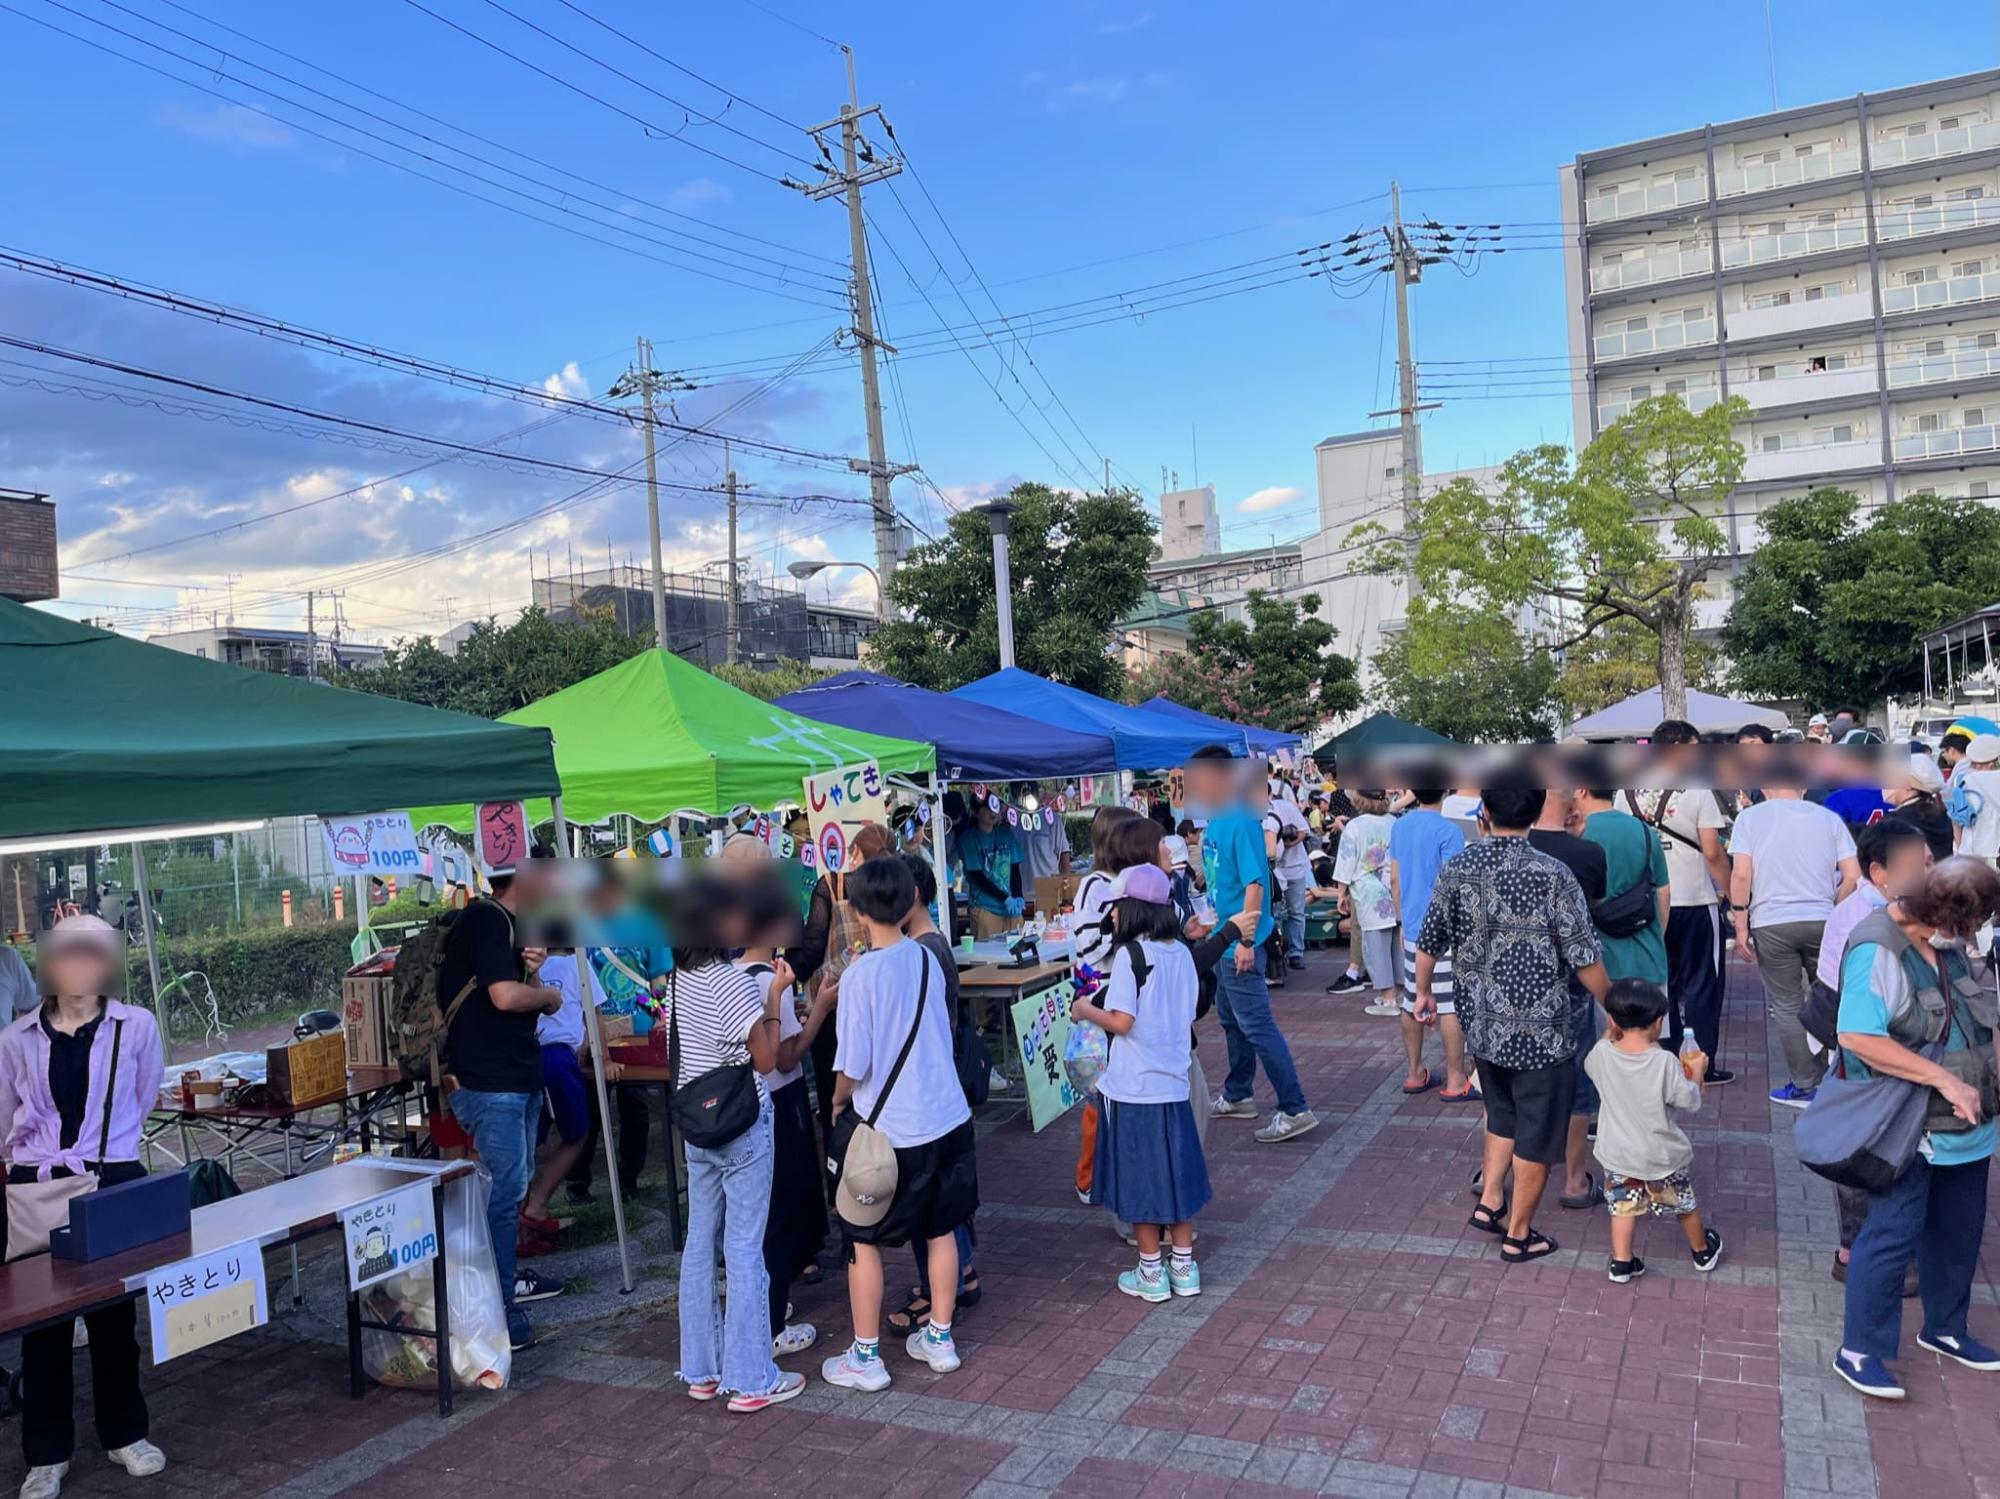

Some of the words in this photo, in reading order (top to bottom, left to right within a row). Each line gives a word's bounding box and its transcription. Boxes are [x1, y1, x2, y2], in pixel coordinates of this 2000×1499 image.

[809, 765, 882, 813] しゃてき
[364, 817, 407, 830] やきとり
[486, 801, 517, 865] やきとり
[372, 850, 420, 868] 100円
[351, 1202, 397, 1228] やきとり
[391, 1233, 436, 1268] 100円
[152, 1258, 242, 1305] やきとり
